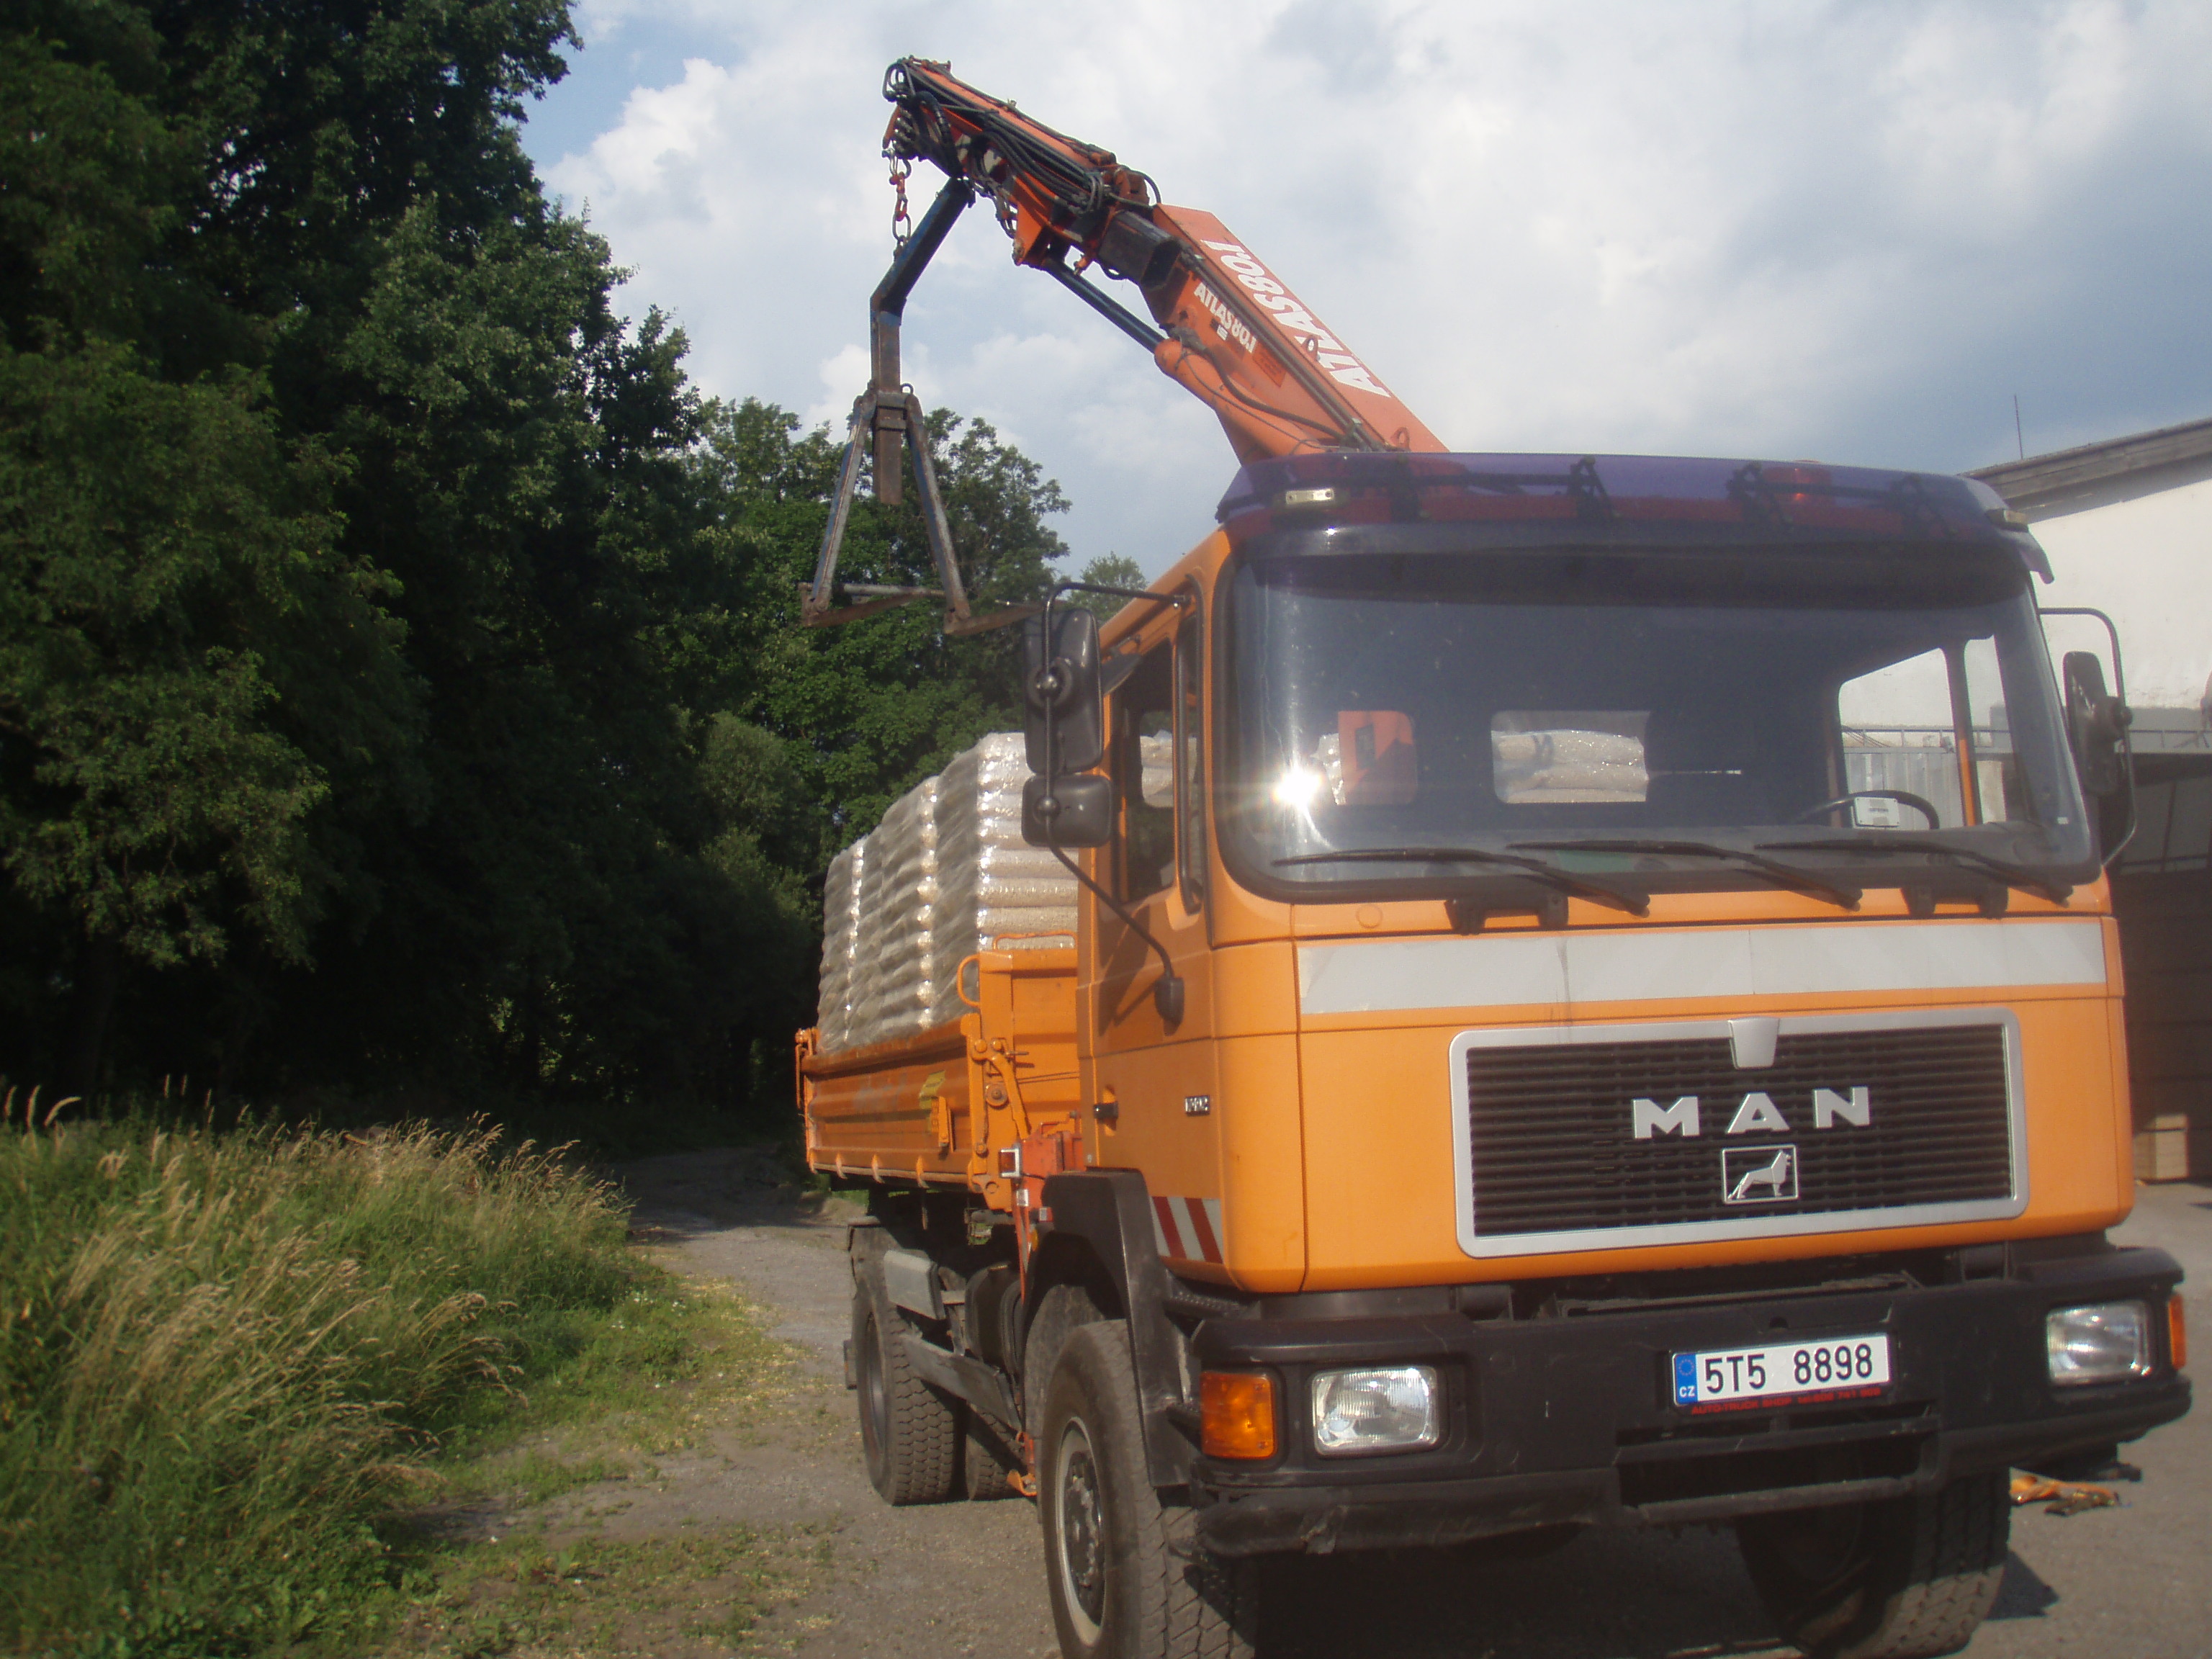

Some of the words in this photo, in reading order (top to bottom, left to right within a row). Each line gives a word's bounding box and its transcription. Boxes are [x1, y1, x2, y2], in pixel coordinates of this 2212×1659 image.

[1632, 1085, 1871, 1139] MAN
[1679, 1385, 1696, 1398] CZ
[1704, 1353, 1766, 1394] 5T5
[1794, 1343, 1872, 1385] 8898
